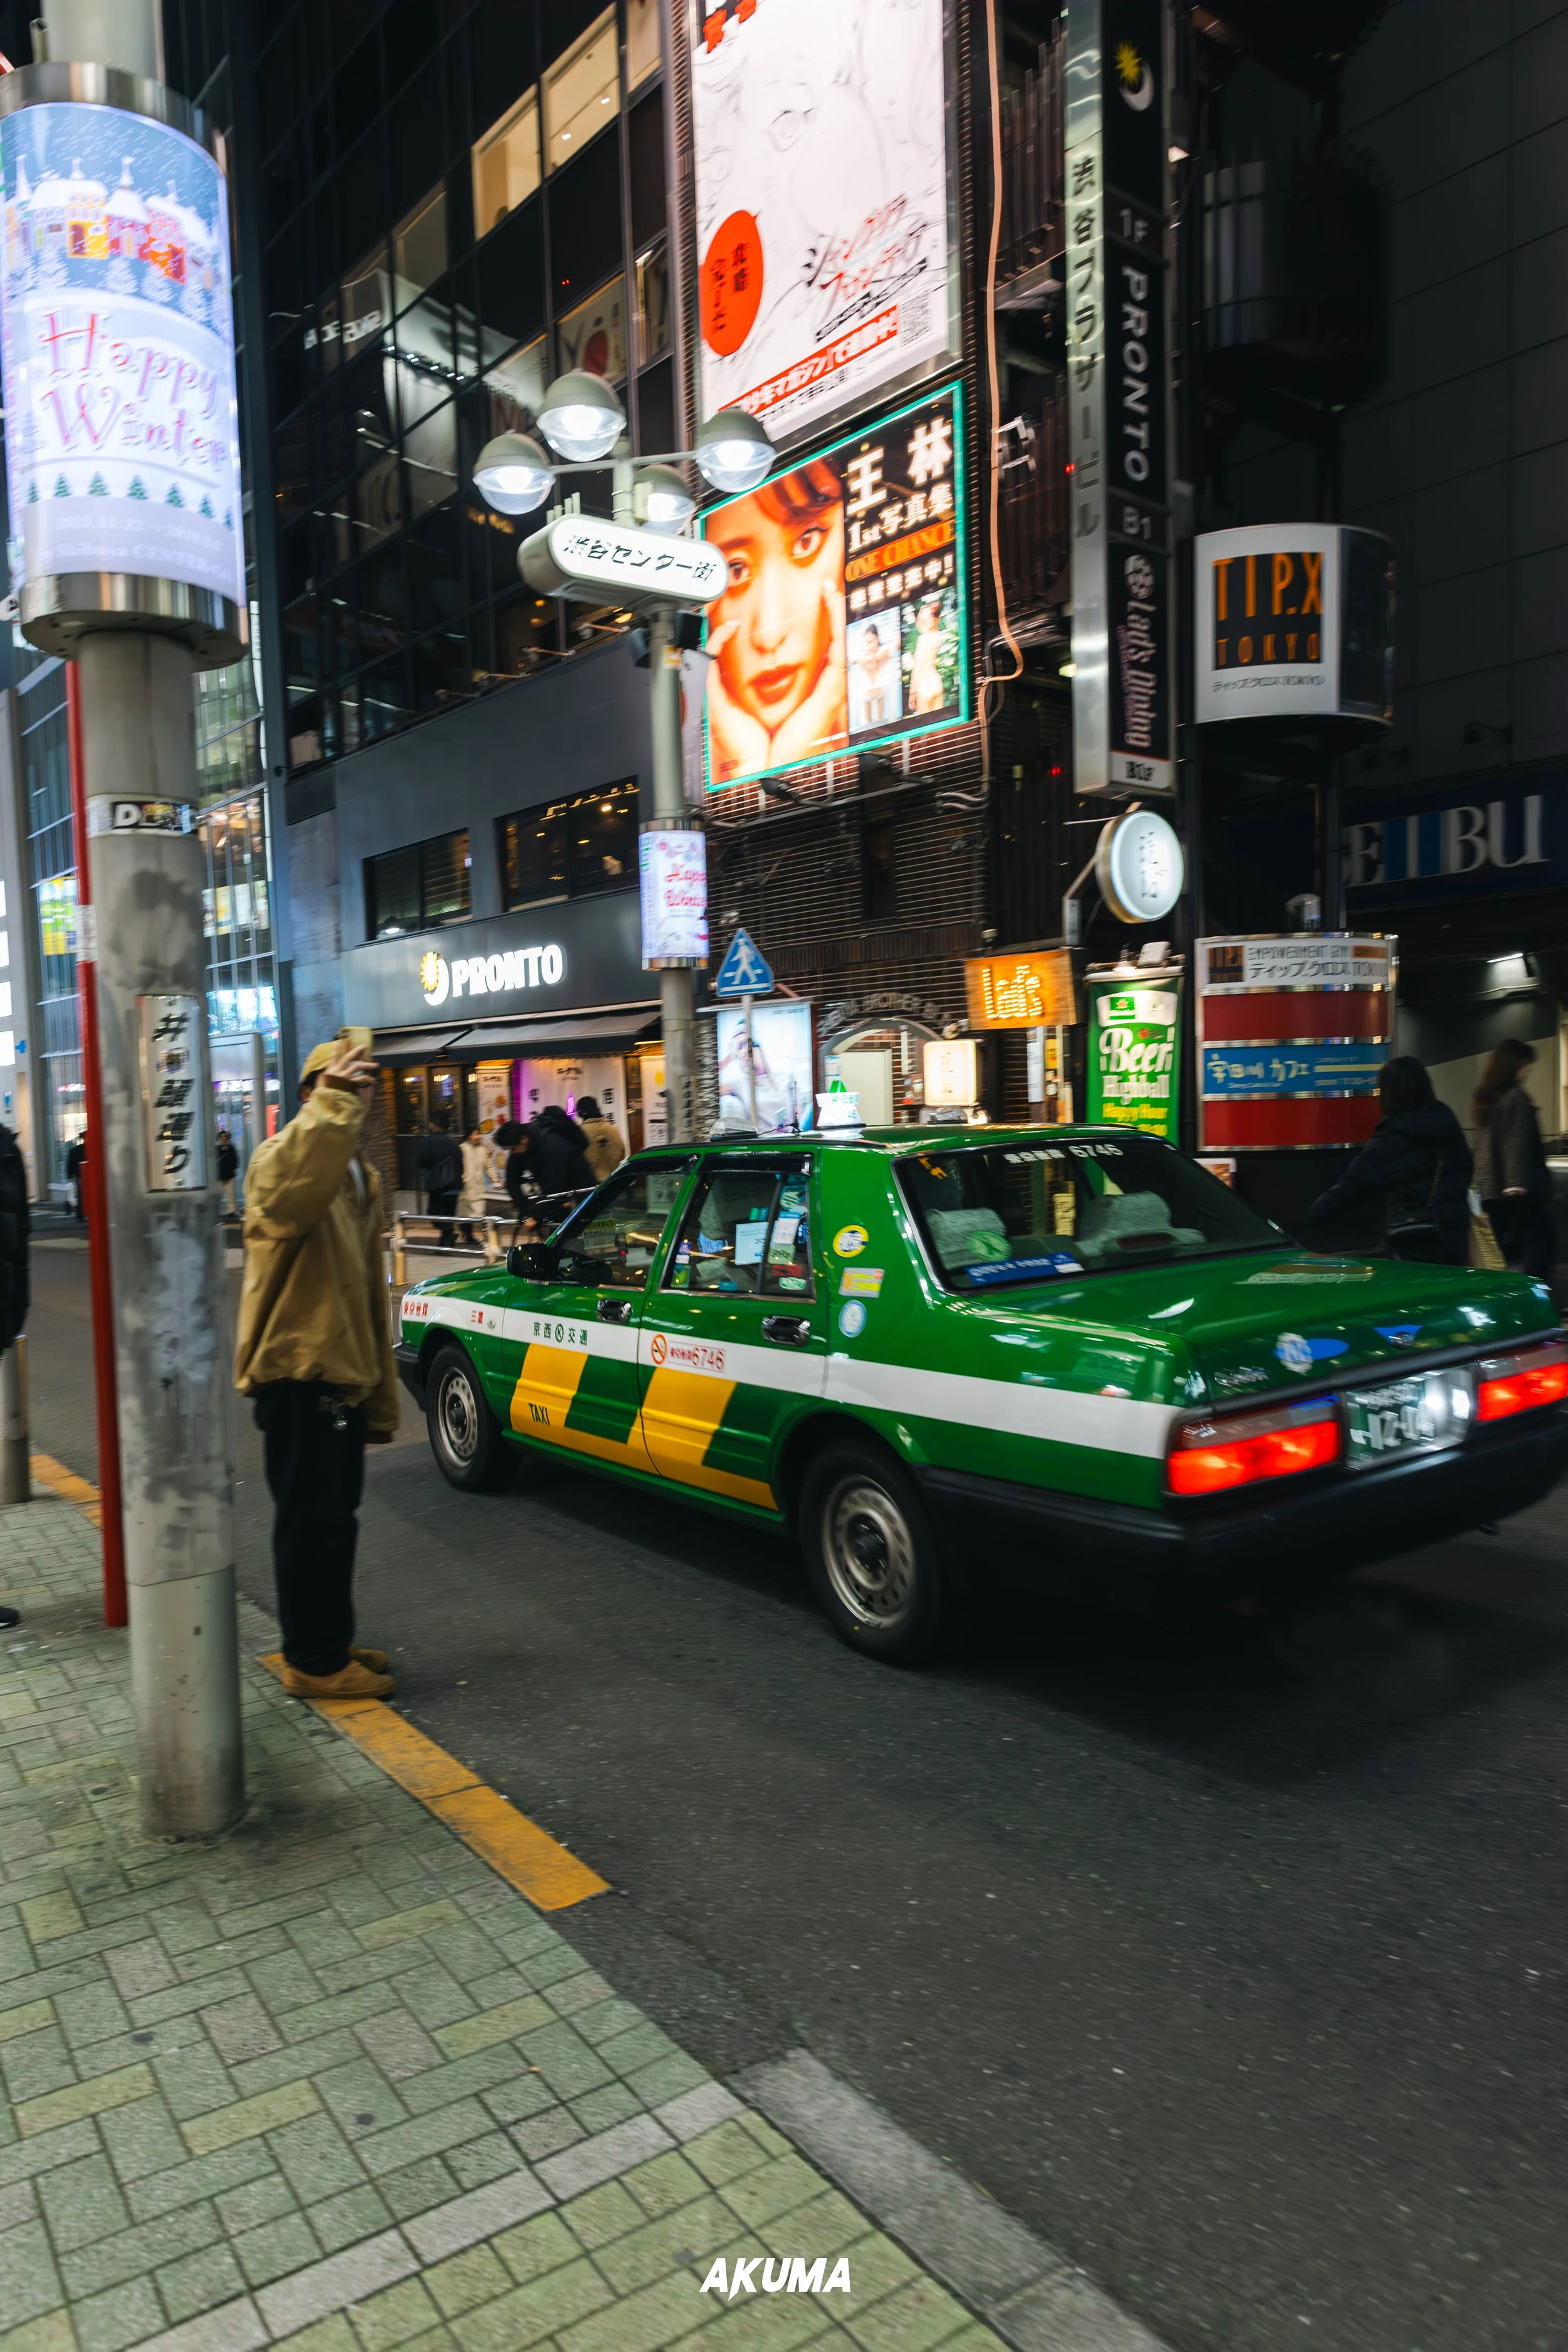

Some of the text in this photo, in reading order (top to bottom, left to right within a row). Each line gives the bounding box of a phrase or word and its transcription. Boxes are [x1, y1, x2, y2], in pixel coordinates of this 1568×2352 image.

[1120, 209, 1148, 243] 1F
[38, 311, 218, 420] Happy
[1122, 264, 1150, 482] PRONTO
[40, 383, 228, 468] Winter
[847, 418, 952, 516] 王林
[847, 482, 954, 552] 1st写真集
[563, 534, 718, 582] 渋谷センター街
[1216, 632, 1320, 667] TOKYO
[1342, 795, 1552, 888] EIBU
[452, 944, 563, 998] PRONTO
[1099, 1027, 1173, 1073] Beer
[151, 1012, 196, 1175] 井頭通り
[1102, 1074, 1170, 1106] Highball
[1068, 1143, 1124, 1158] 6746
[533, 1321, 551, 1339] 京西
[568, 1327, 588, 1346] 交通
[692, 1347, 725, 1370] 6746
[527, 1402, 551, 1426] TAXI
